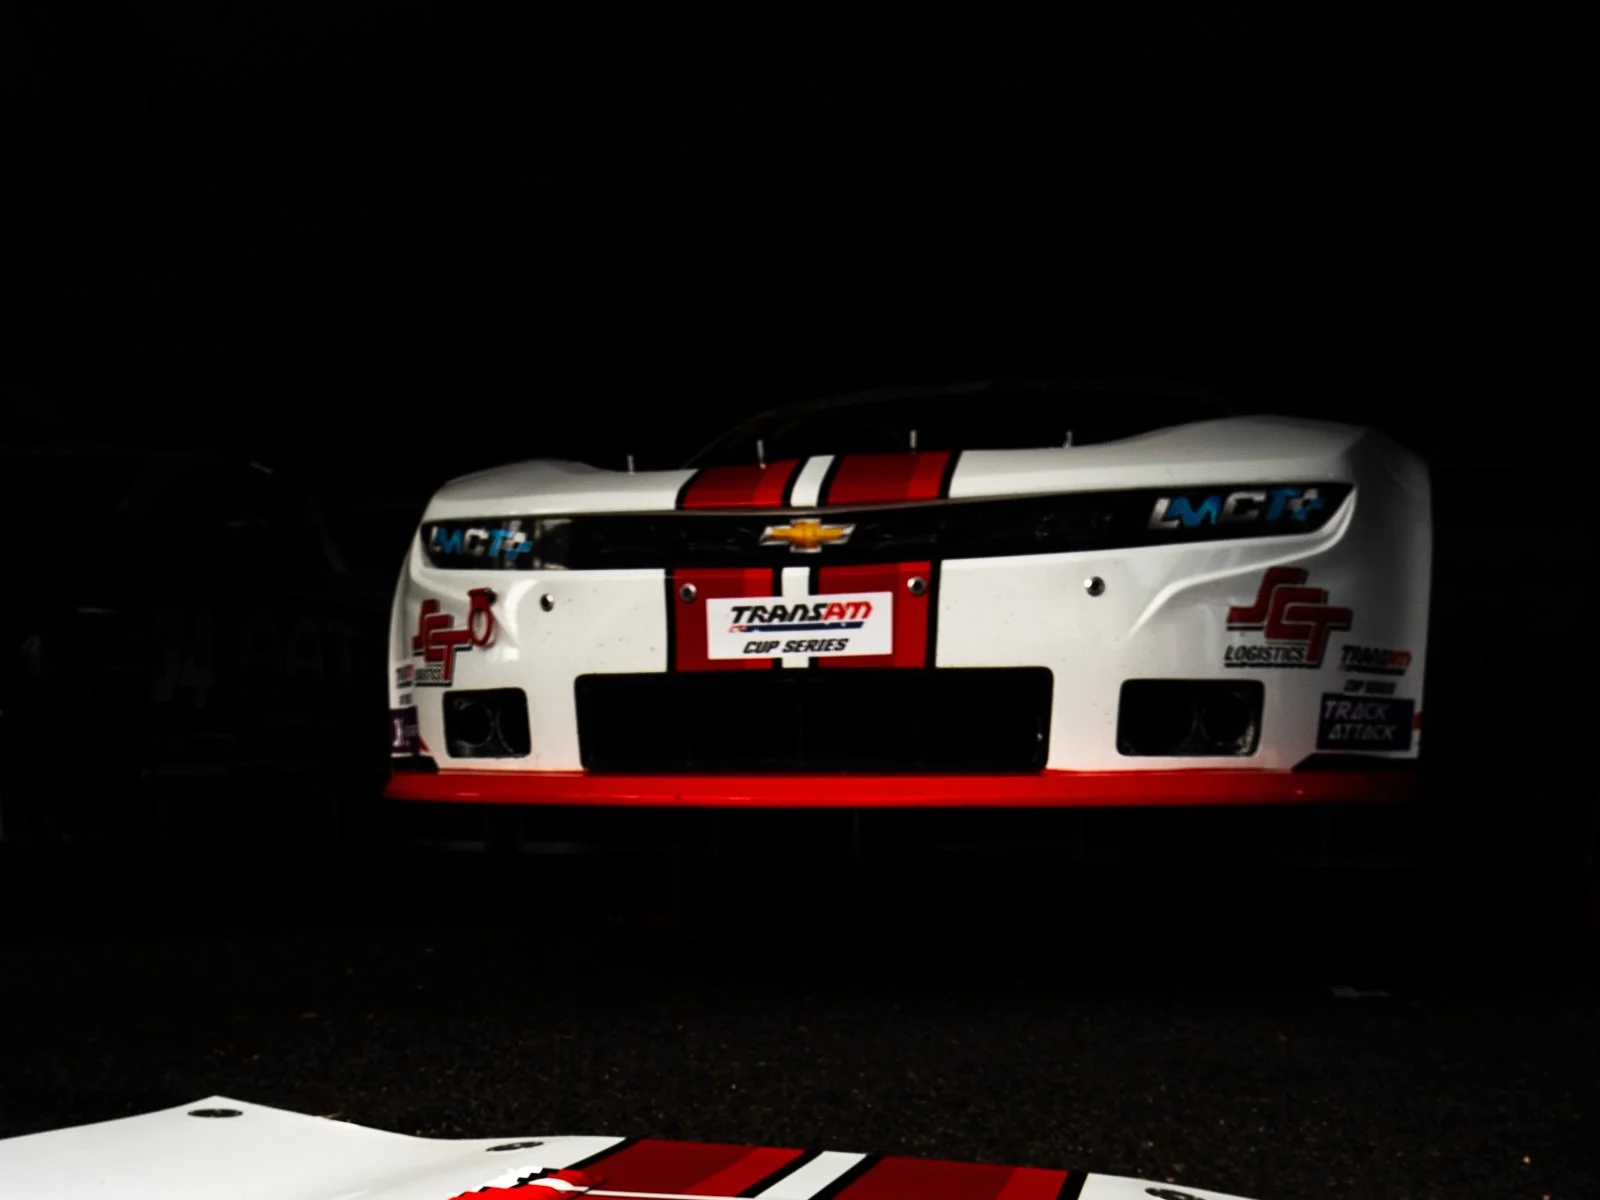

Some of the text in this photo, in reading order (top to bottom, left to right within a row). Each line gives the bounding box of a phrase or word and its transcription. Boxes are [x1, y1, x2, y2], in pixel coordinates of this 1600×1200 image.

[743, 637, 849, 655] CUP SERIES
[1224, 645, 1307, 664] LOGISTICS
[1323, 700, 1390, 721] TRACK
[1327, 723, 1398, 742] ATTACK
